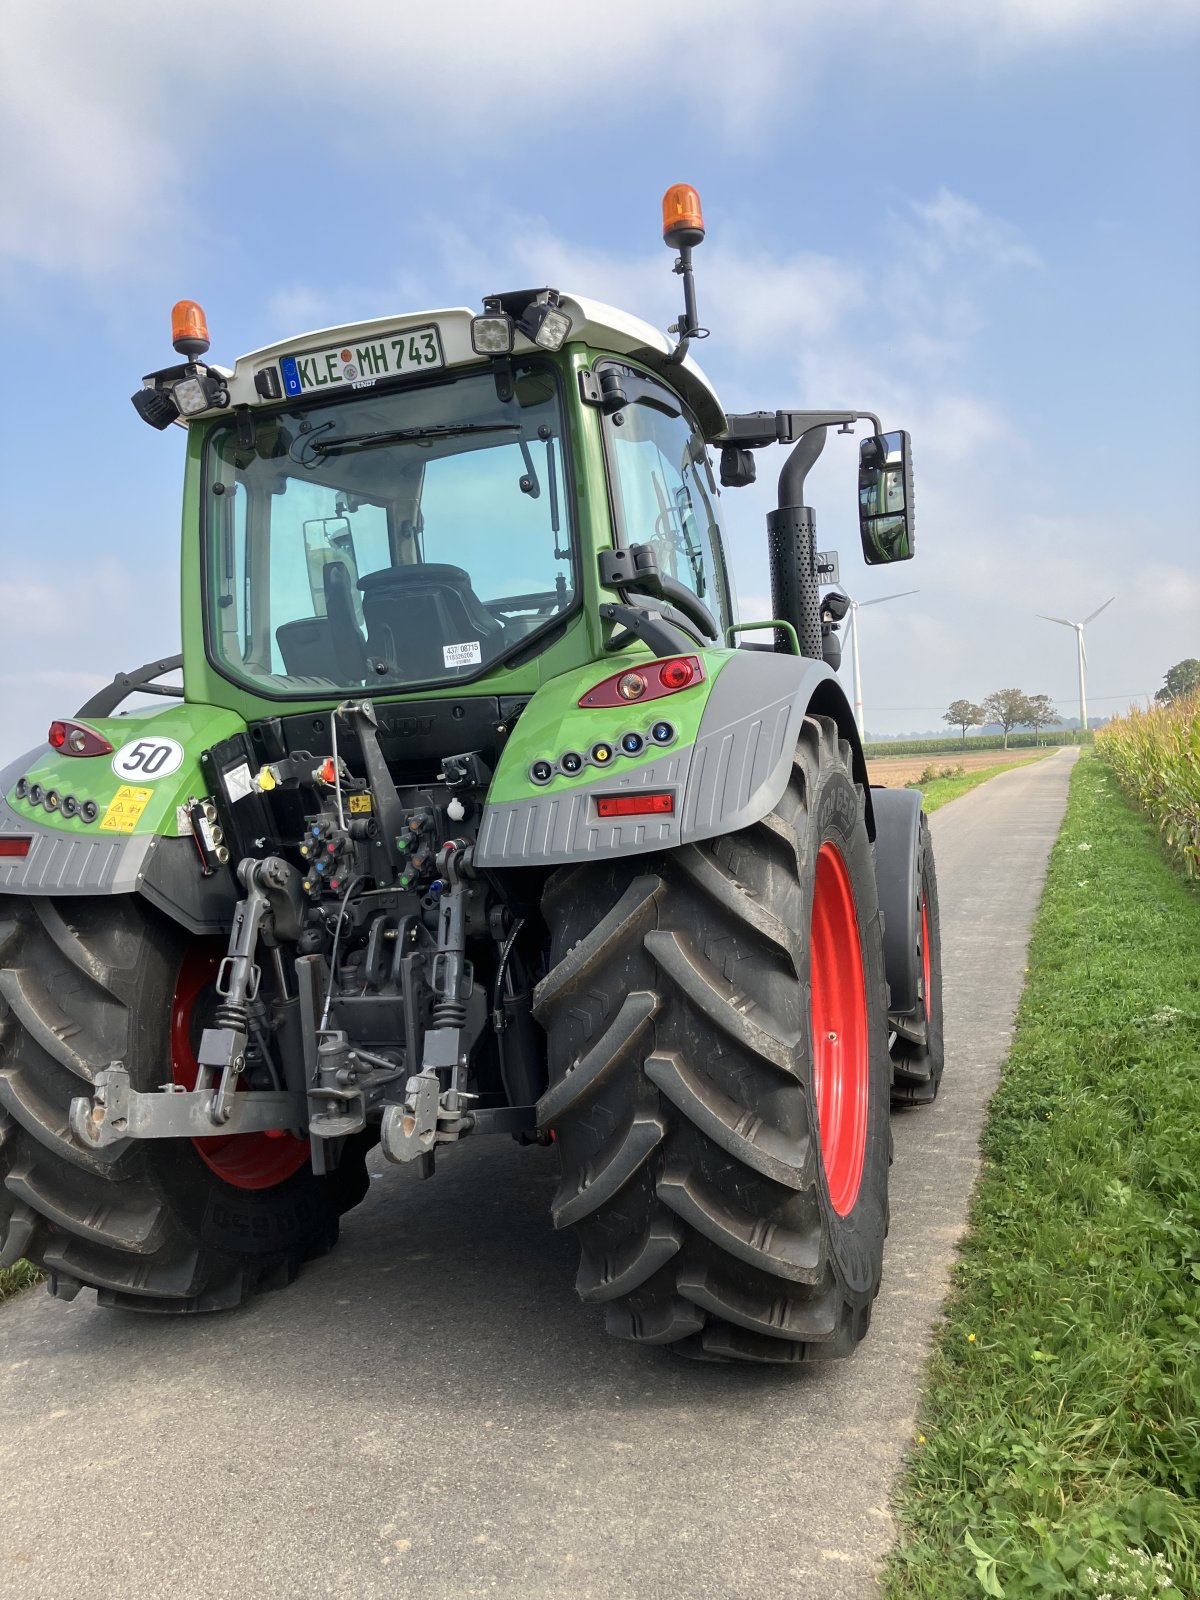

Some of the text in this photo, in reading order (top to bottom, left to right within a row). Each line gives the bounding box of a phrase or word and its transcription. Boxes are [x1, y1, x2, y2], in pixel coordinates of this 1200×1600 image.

[297, 333, 437, 388] KLE MH 743
[290, 380, 297, 389] D
[352, 379, 377, 389] FENDT
[123, 743, 173, 774] 50
